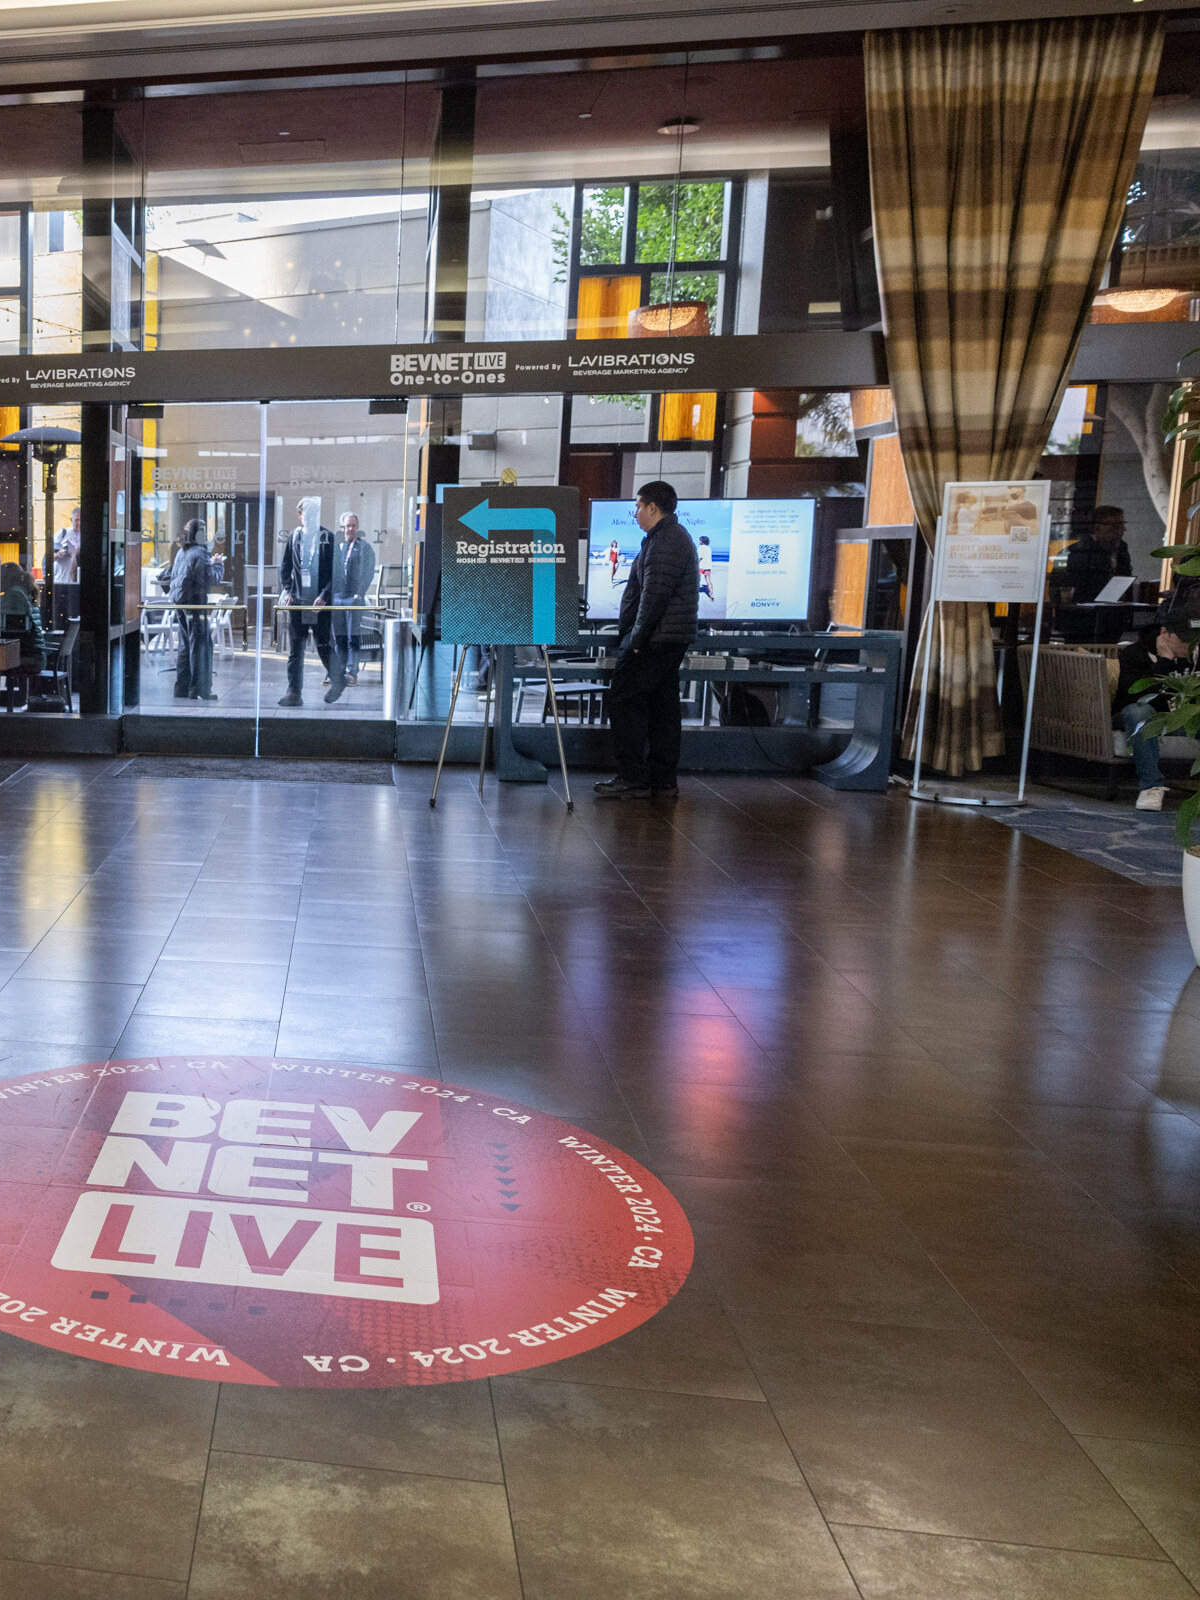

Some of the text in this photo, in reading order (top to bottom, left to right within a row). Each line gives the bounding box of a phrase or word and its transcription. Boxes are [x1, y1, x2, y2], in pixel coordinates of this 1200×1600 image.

[474, 352, 506, 369] LIVE
[552, 363, 562, 372] By
[568, 353, 695, 367] LAVIBRATIONS
[10, 376, 21, 384] By
[26, 367, 136, 380] LAVIBRATIONS
[390, 372, 506, 385] One-to-Ones
[456, 540, 565, 557] Registration
[93, 1063, 159, 1078] 2024
[187, 1060, 231, 1070] CA
[271, 1062, 533, 1125] WINTER 2024 CA
[109, 1091, 423, 1154] BEV
[558, 1135, 663, 1270] WINTER 2024 CA
[90, 1203, 404, 1288] LIVE
[302, 1287, 638, 1372] WINTER 2024 CA
[50, 1316, 230, 1367] WINTER
